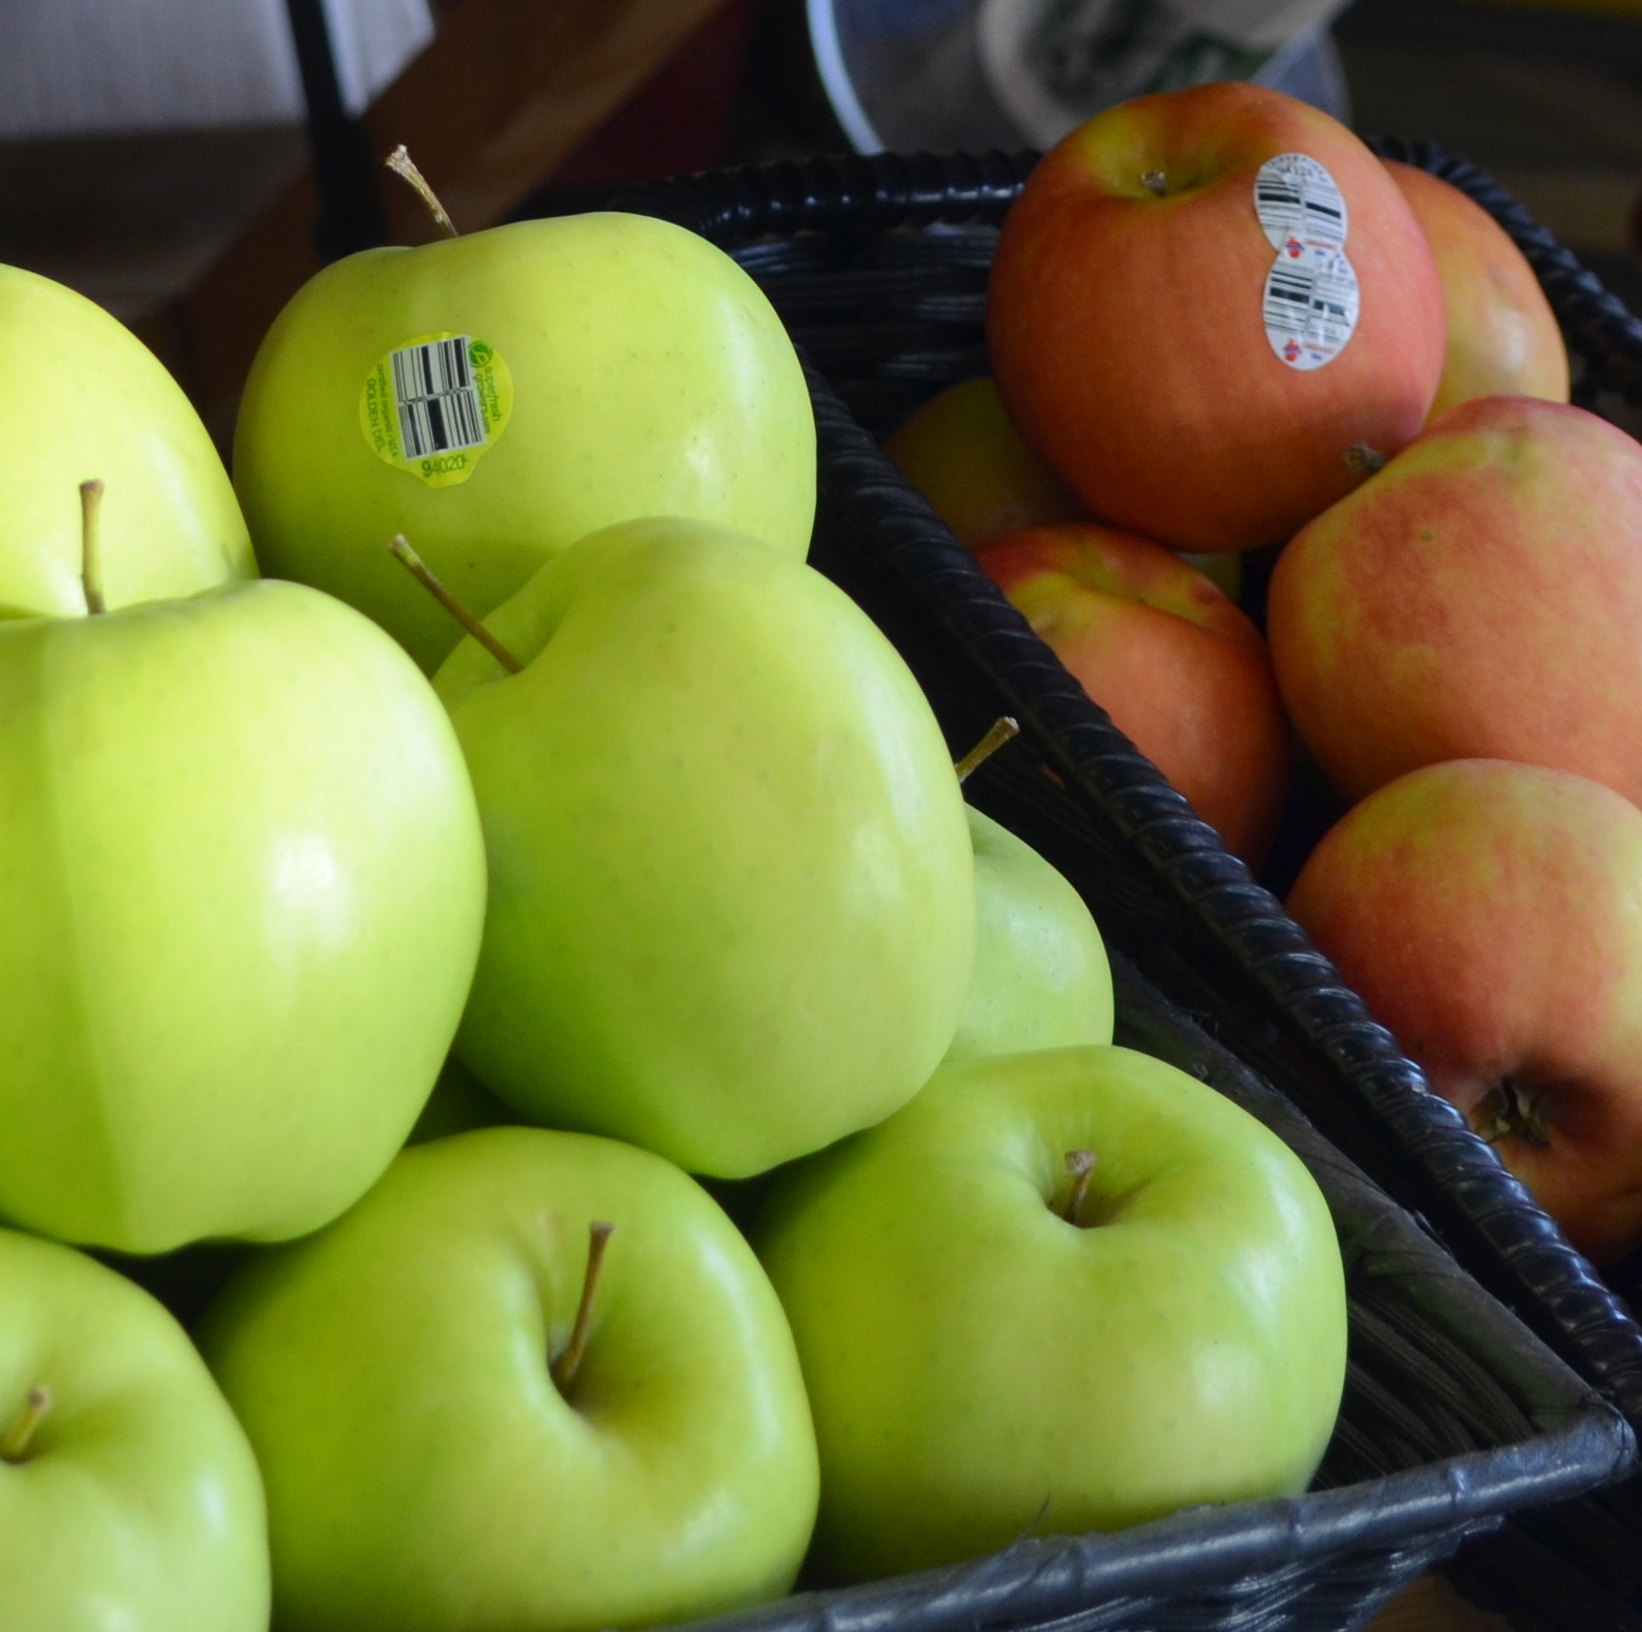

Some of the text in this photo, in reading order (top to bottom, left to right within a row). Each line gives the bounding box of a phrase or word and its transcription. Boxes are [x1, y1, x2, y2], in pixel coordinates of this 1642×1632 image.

[367, 378, 385, 454] GOLDEN DEL
[484, 367, 502, 422] superfresh
